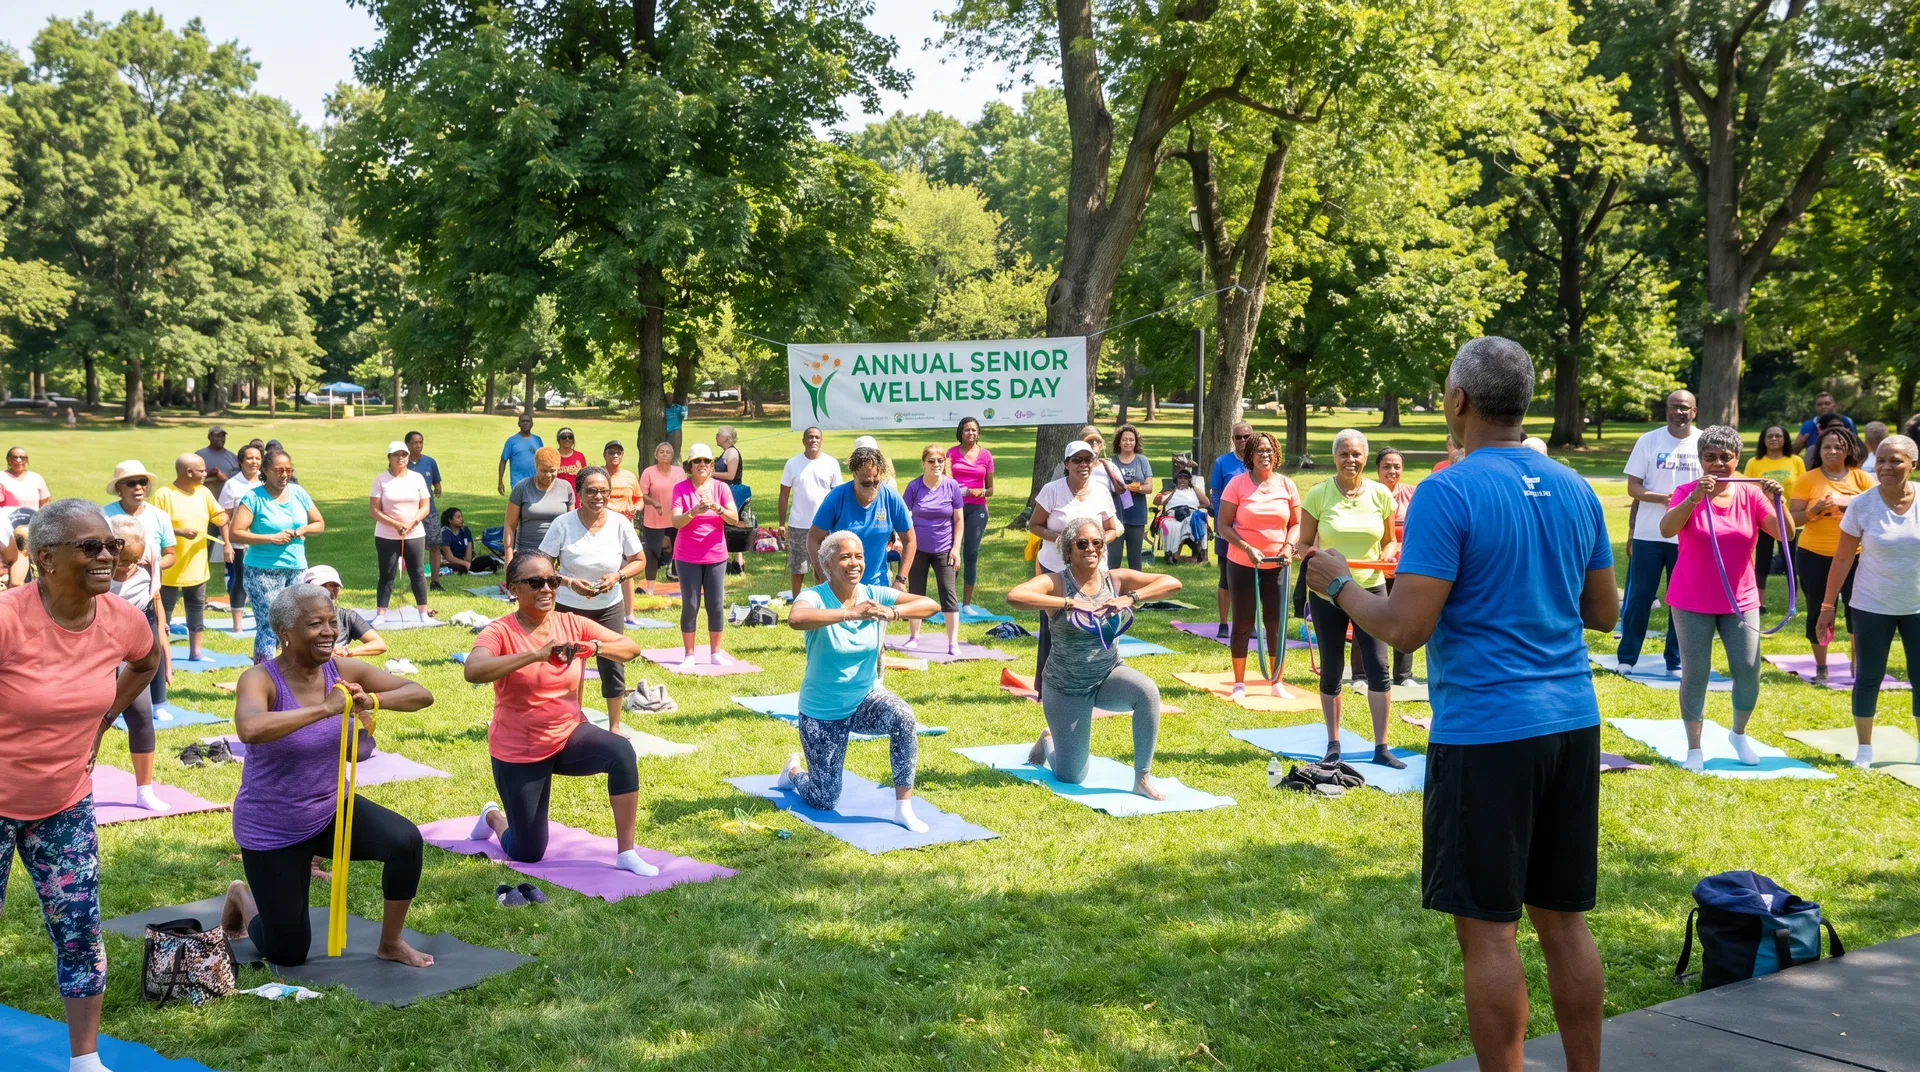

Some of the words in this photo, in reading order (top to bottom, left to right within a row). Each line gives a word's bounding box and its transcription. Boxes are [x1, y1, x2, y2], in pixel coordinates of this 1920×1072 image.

[851, 352, 963, 376] ANNUAL
[970, 349, 1069, 373] SENIOR
[860, 379, 1001, 404] WELLNESS
[1009, 376, 1061, 400] DAY
